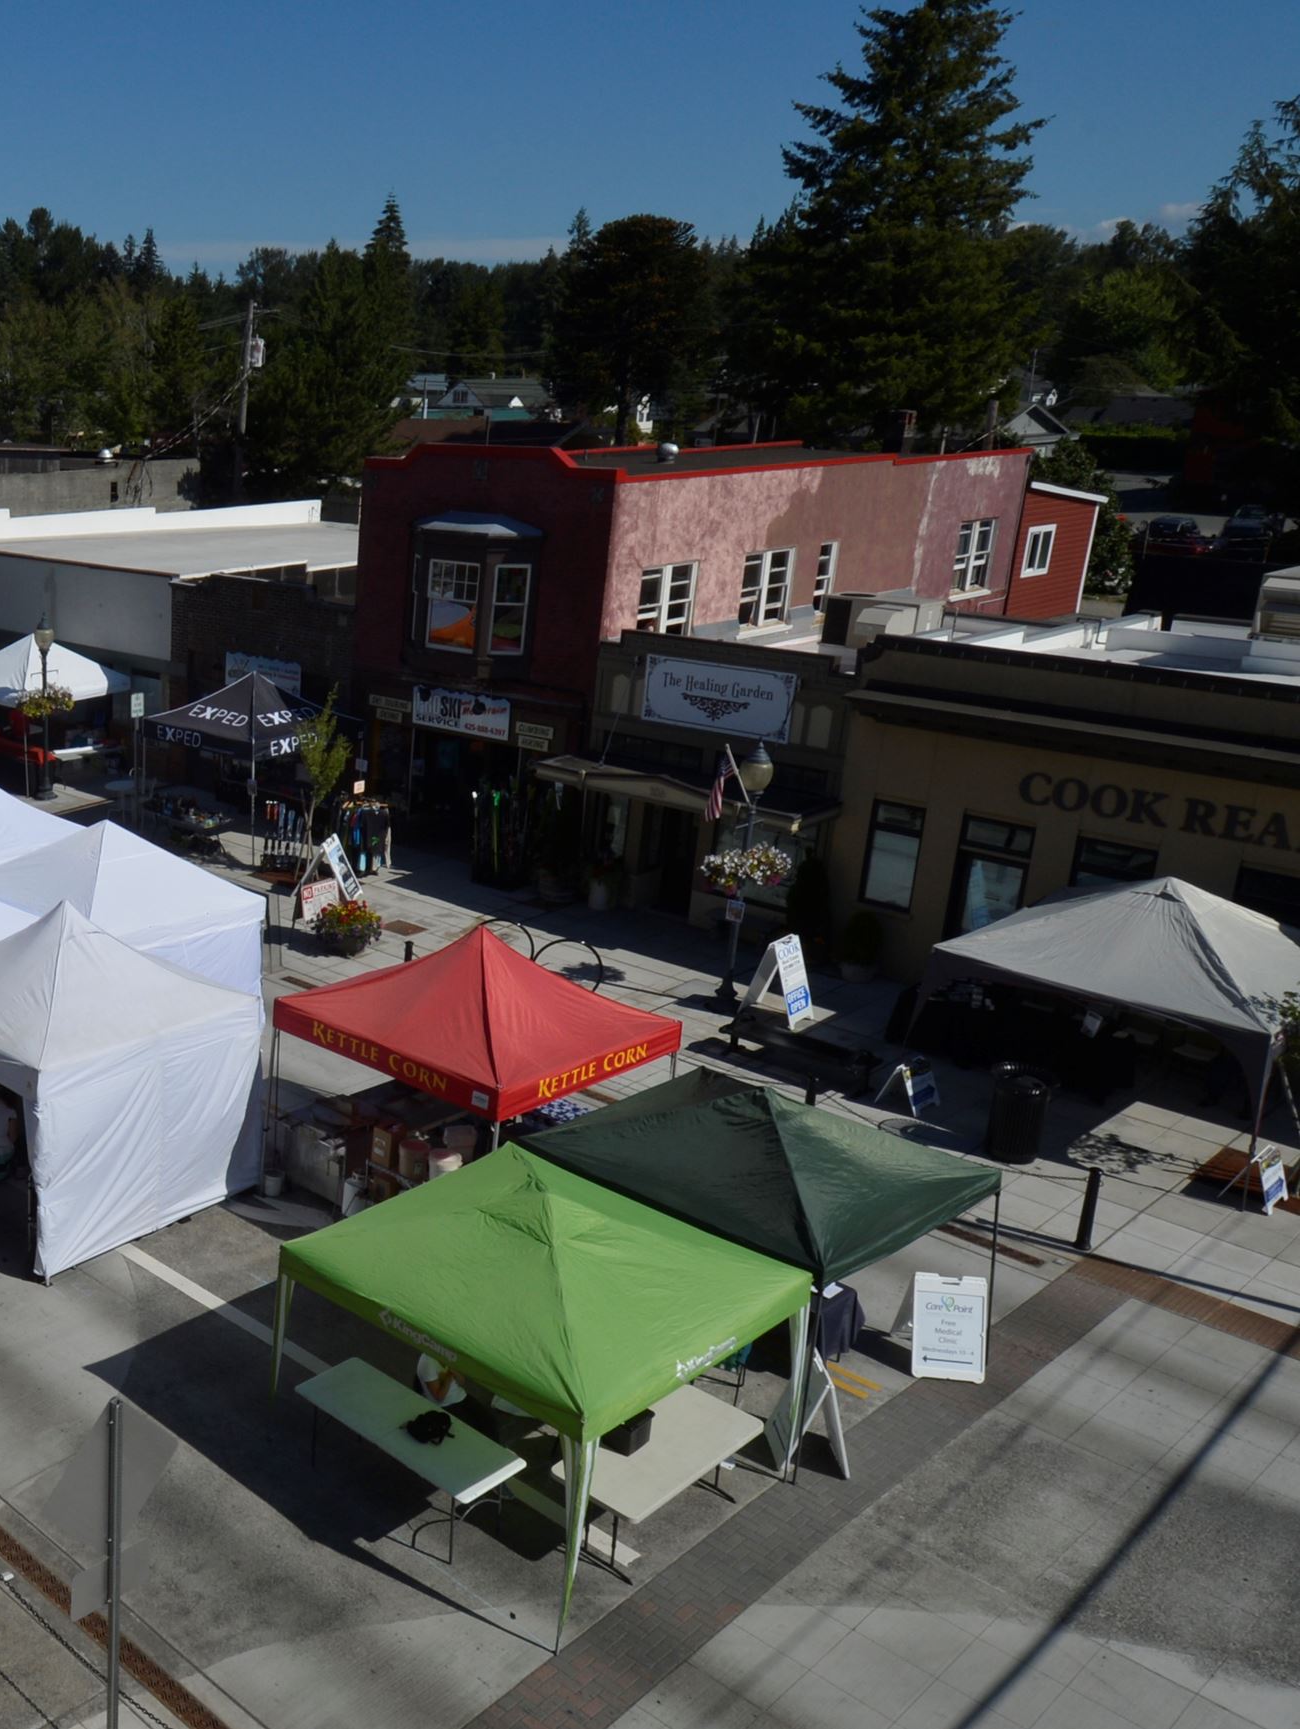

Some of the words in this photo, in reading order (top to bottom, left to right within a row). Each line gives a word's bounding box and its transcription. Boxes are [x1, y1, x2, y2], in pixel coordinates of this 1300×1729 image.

[662, 671, 682, 688] The
[685, 674, 728, 696] Healing
[731, 681, 774, 701] Garden
[188, 704, 249, 727] EXPED
[256, 706, 317, 728] EXPED
[415, 713, 461, 729] SERVICE
[461, 704, 508, 717] Motain
[156, 725, 201, 747] EXPED
[269, 732, 318, 757] EXPED
[1019, 771, 1170, 829] COOK
[1179, 797, 1300, 852] REA
[778, 943, 800, 961] COOK
[786, 988, 807, 1003] OFFICE
[789, 998, 806, 1013] OPEN
[312, 1020, 380, 1063] KETTLE
[388, 1053, 449, 1092] CORN
[537, 1062, 597, 1099] KETTLE
[602, 1043, 649, 1073] CORN
[935, 1327, 963, 1336] Medical
[941, 1319, 956, 1327] Free
